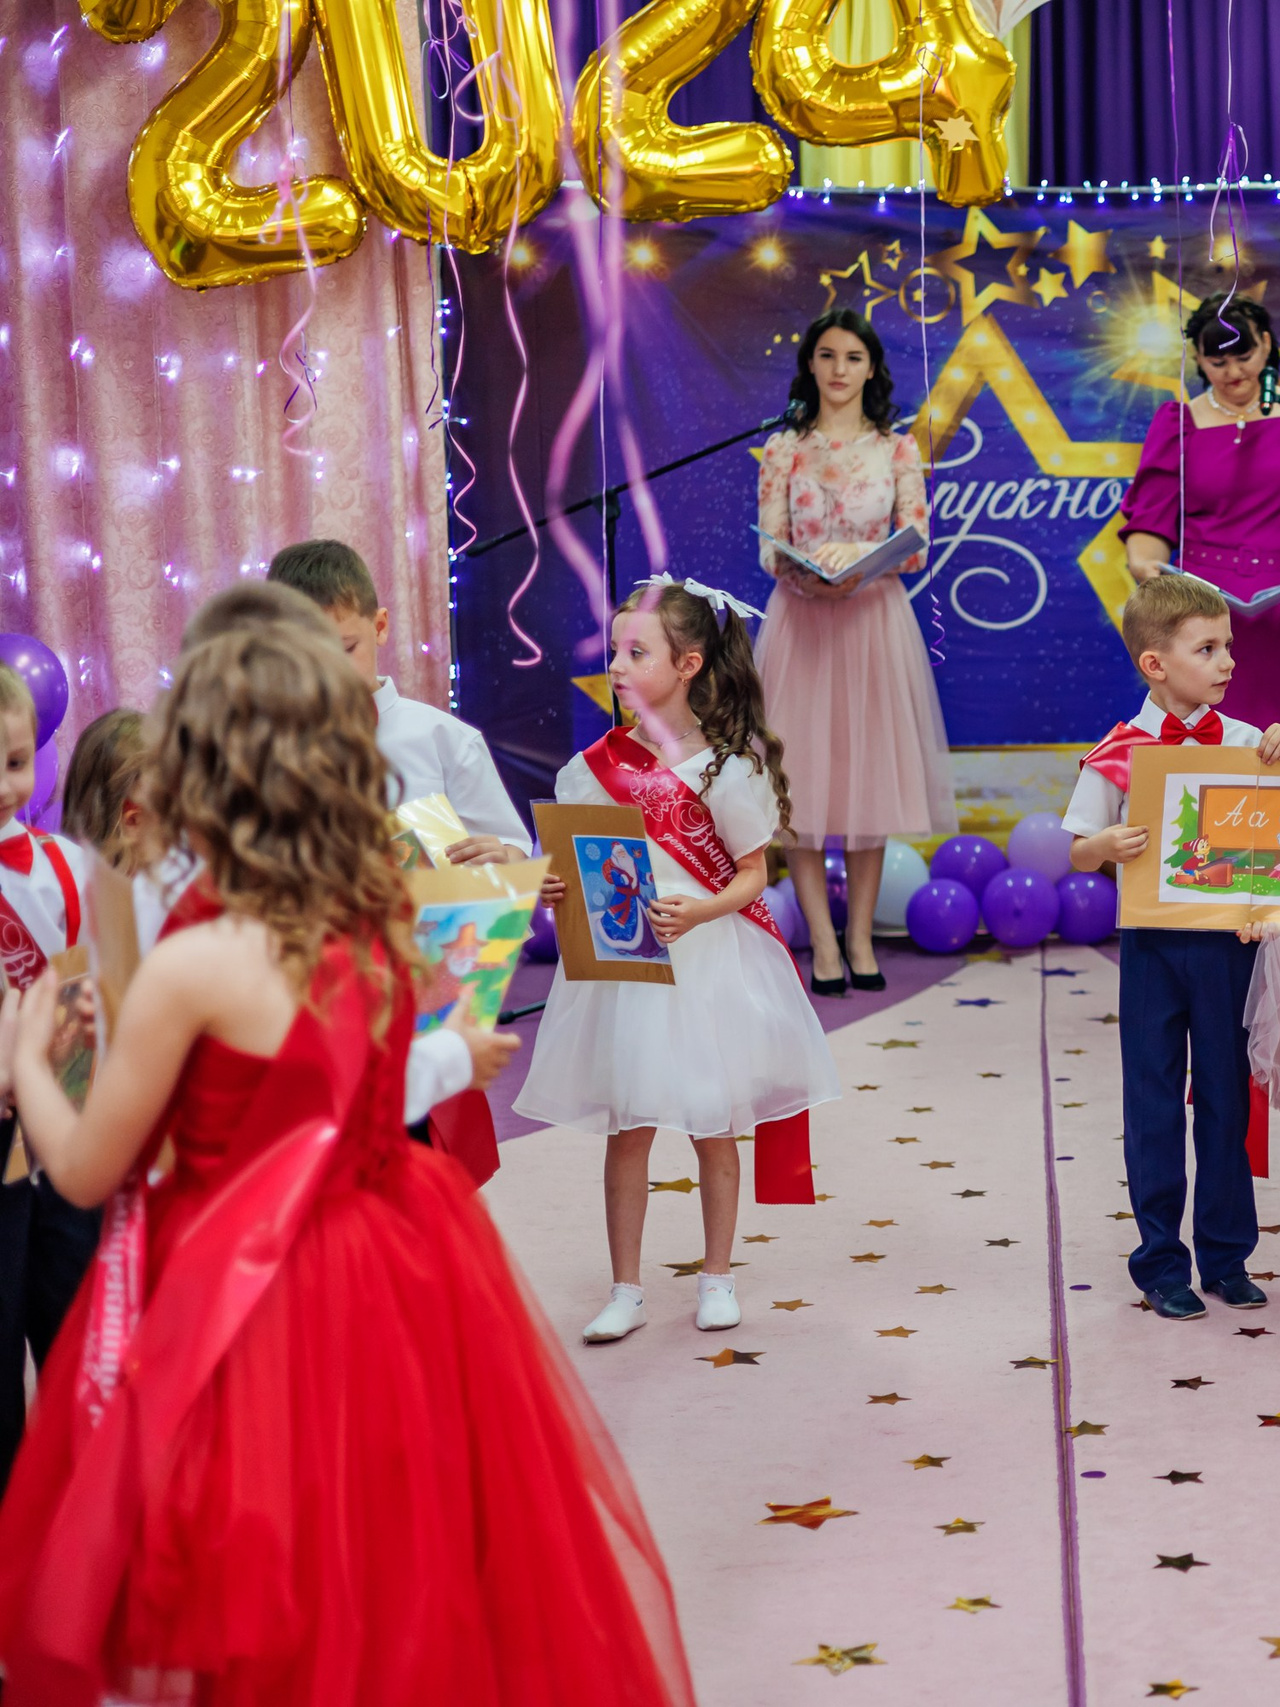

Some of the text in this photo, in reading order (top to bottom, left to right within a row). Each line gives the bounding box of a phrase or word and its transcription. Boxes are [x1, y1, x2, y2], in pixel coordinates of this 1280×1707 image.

[78, 0, 1018, 290] 2024
[657, 832, 709, 877] детского
[710, 877, 726, 894] сад
